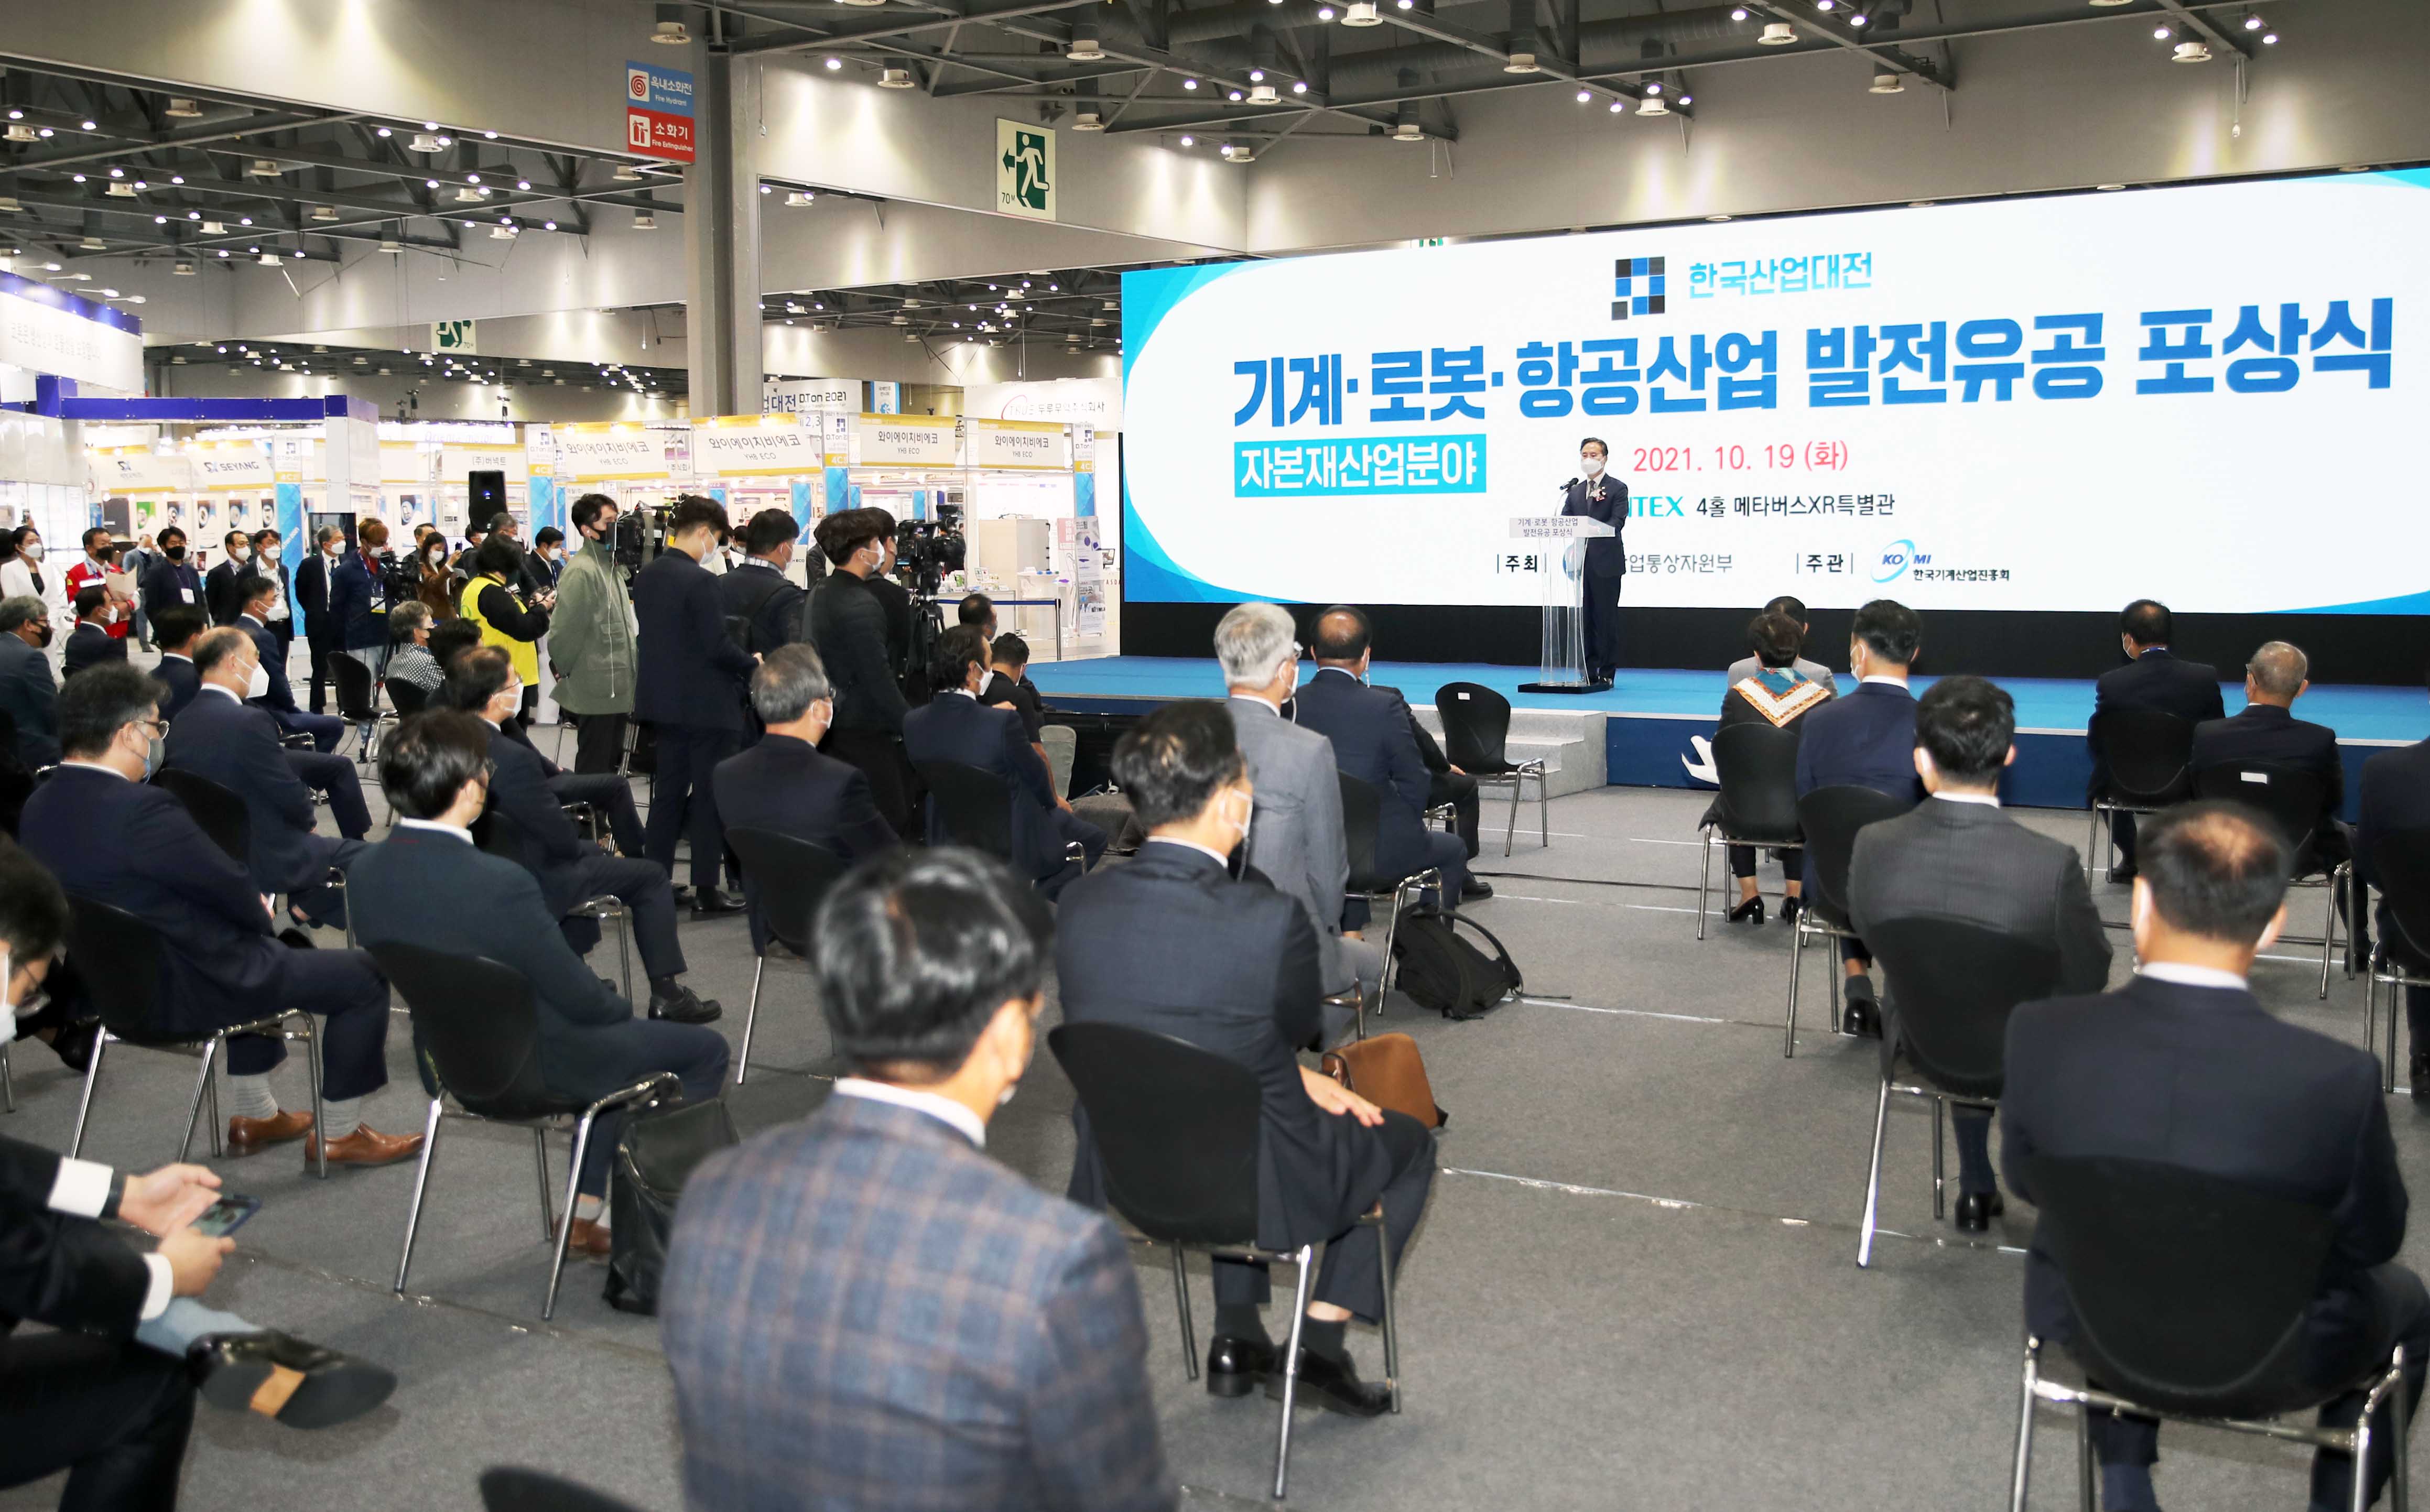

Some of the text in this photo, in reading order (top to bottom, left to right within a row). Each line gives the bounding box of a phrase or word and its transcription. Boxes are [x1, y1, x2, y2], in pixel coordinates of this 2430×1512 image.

[650, 76, 692, 95] 옥내소화전
[666, 96, 687, 106] Hydrant
[655, 122, 688, 140] 소화기
[652, 139, 693, 152] Fire Extinguisher
[1689, 252, 1872, 299] 한국산업대전
[1806, 312, 2106, 408] 발전유공
[2135, 297, 2394, 395] 포상식
[825, 391, 847, 401] 2021
[709, 434, 801, 450] 와이에이치비에코
[878, 430, 938, 444] 와이에이치비에코
[995, 436, 1049, 448] 와이에이치비에코
[567, 441, 650, 454] 와이에이치비에코
[1633, 440, 1848, 472] 2021. 10. 19 (화)
[220, 461, 260, 471] SEYANG
[1241, 441, 1477, 489] 자본재산업분야
[1696, 496, 1726, 518] 4홀
[1734, 494, 1895, 517] 메타버스XR특별관
[1523, 528, 1572, 537] 발전유공 포상식
[1505, 554, 1537, 573] 주최
[1625, 553, 1732, 574] 업통상자원부
[1806, 553, 1844, 573] 주관
[1913, 569, 2010, 581] 한국기계산업진흥회
